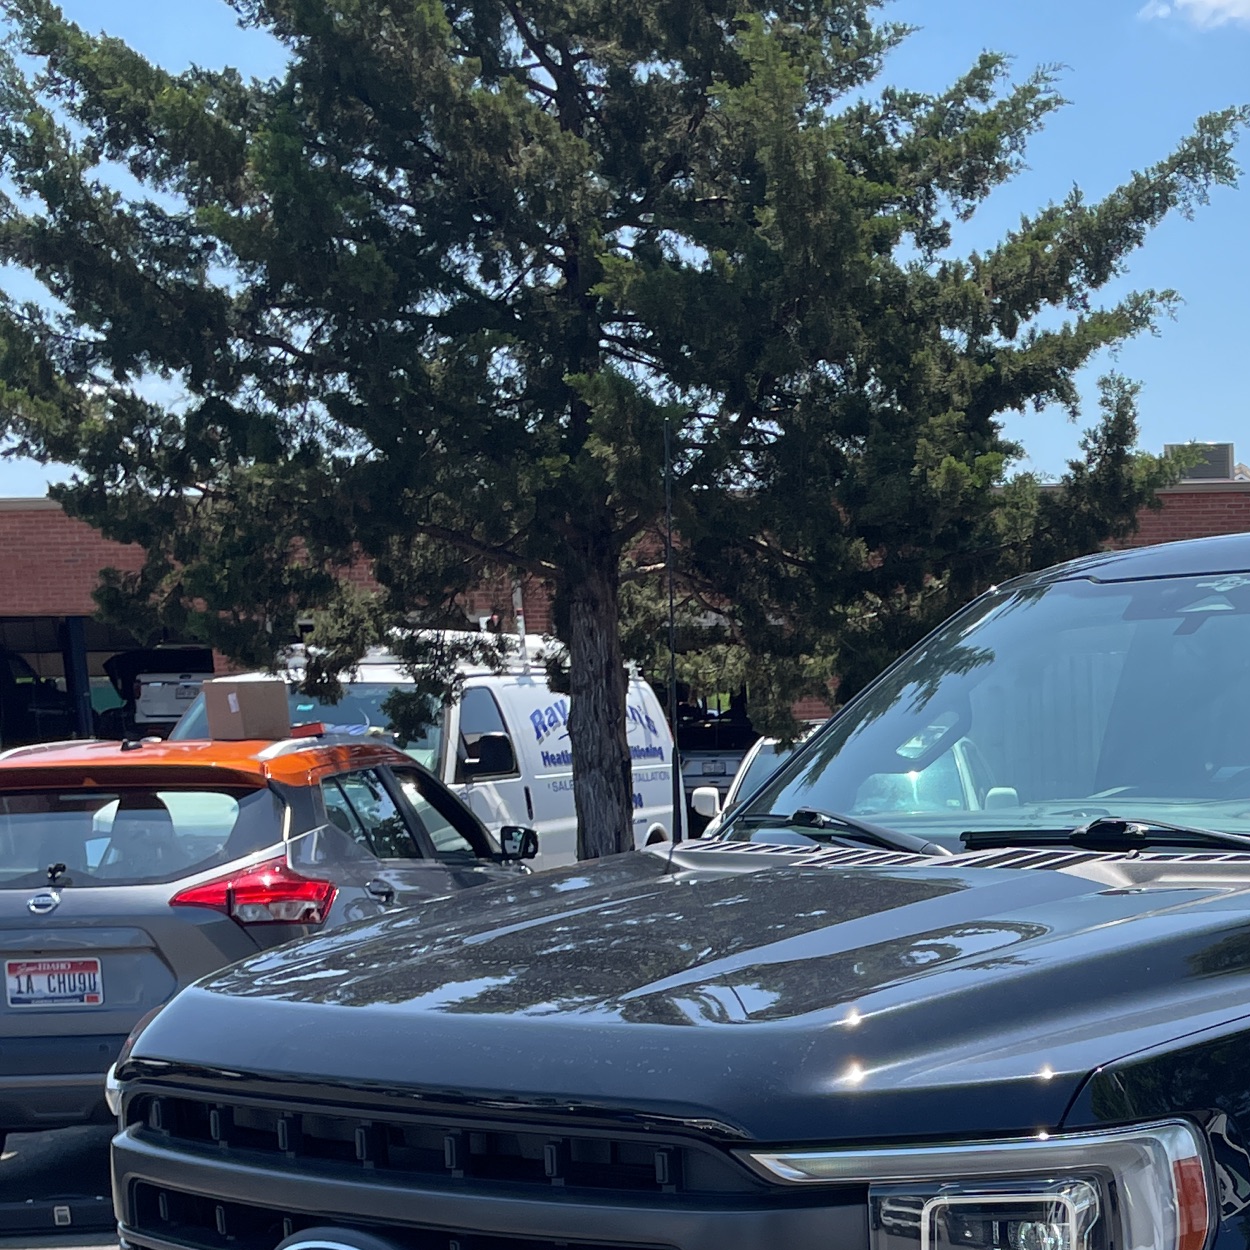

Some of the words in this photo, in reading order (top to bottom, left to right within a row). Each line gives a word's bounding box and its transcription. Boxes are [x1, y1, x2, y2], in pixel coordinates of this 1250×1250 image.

[552, 780, 574, 793] SALE
[37, 962, 72, 972] IDAHO
[15, 974, 35, 995] 1A
